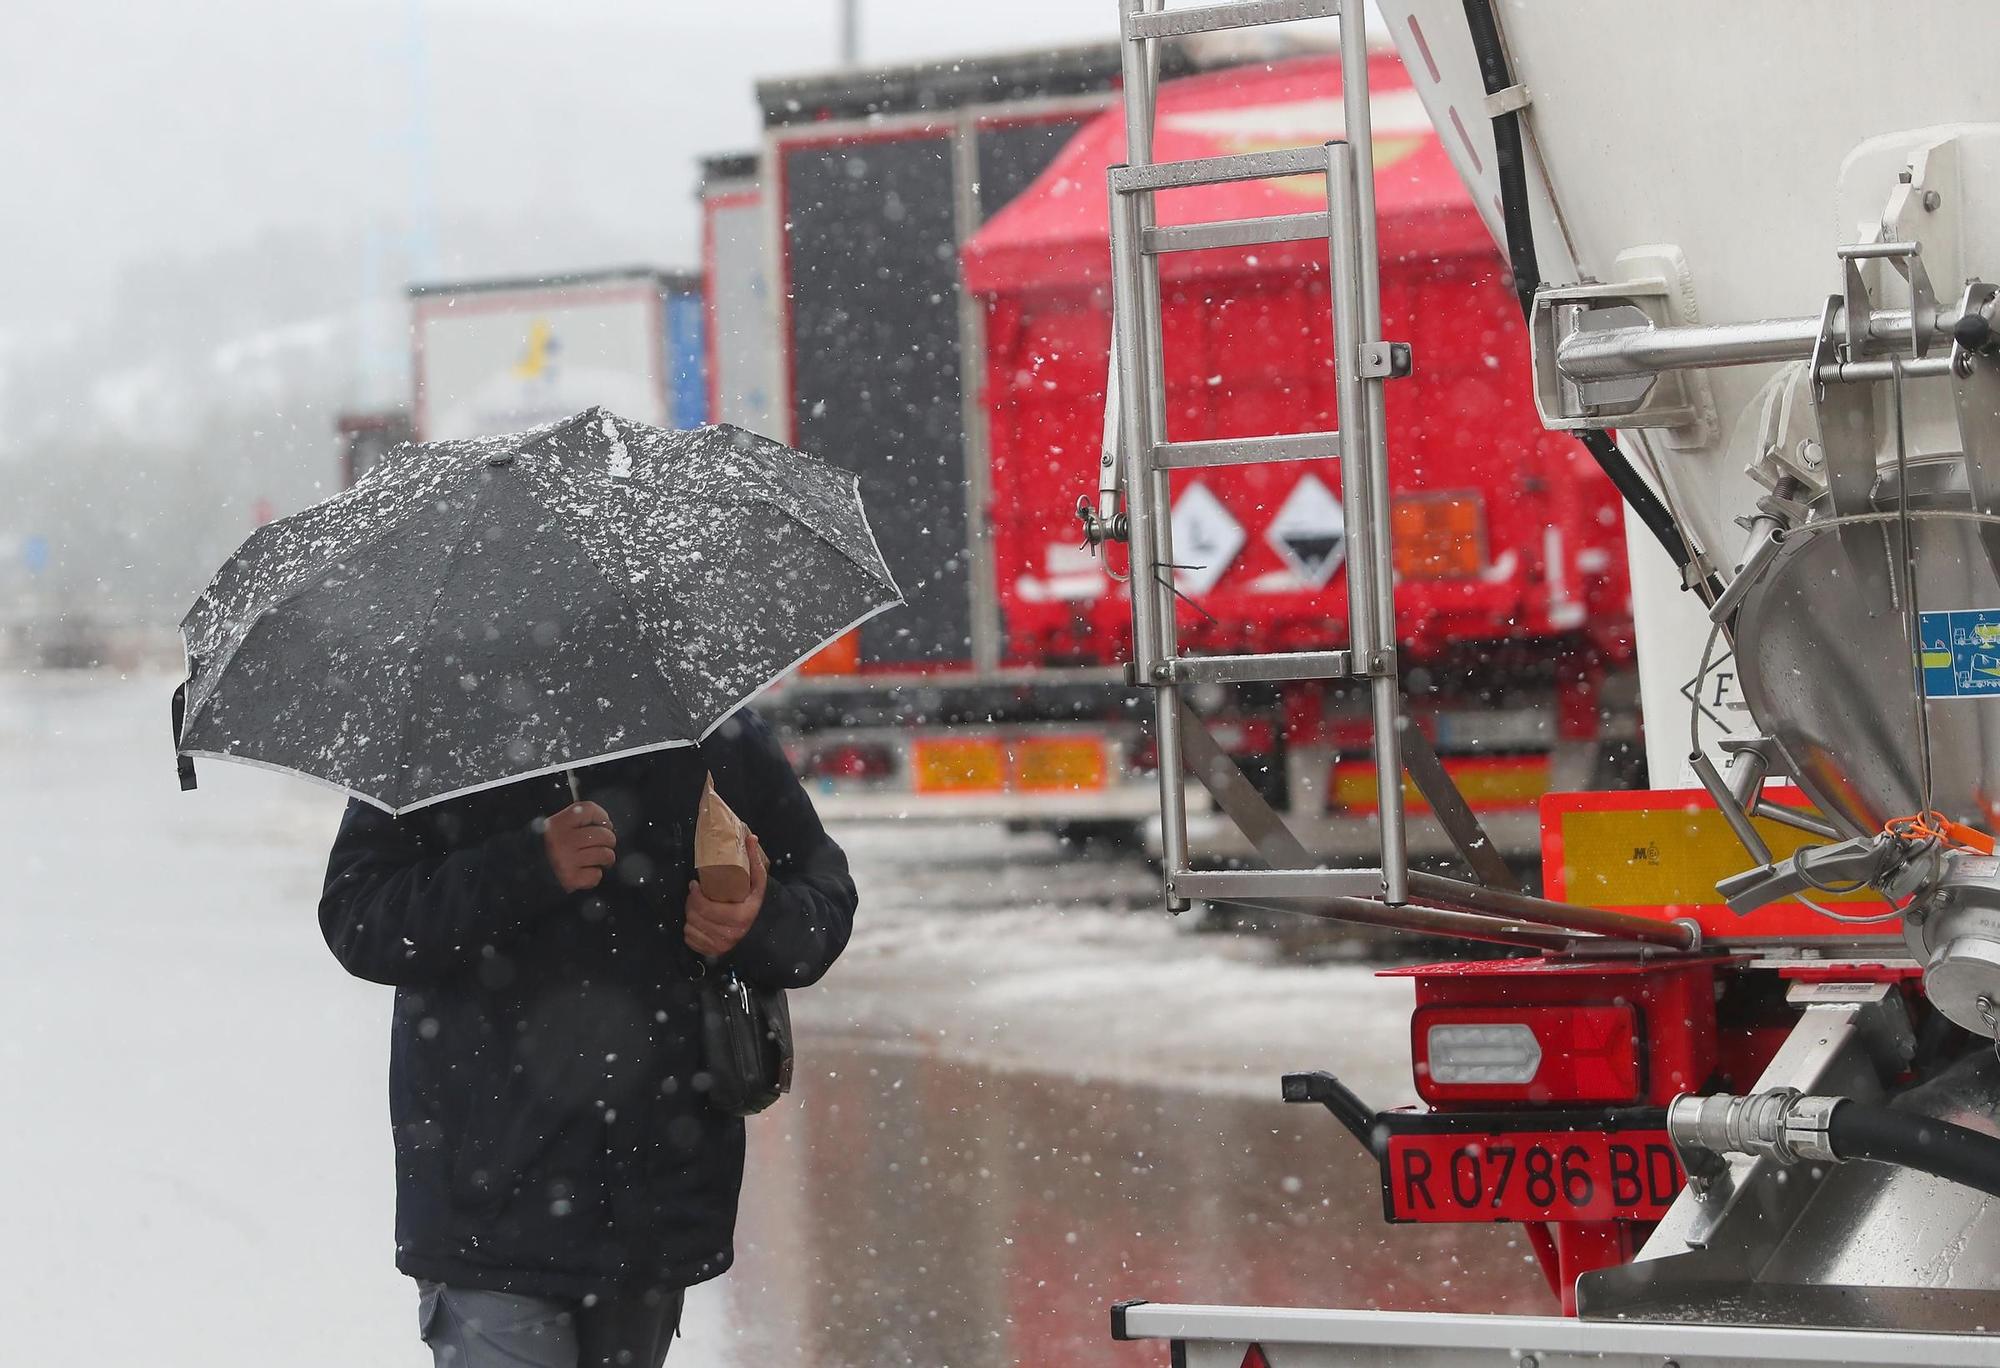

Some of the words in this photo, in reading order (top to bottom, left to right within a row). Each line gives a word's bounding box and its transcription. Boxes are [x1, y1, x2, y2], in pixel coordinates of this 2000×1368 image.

[1713, 673, 1733, 706] F
[1403, 1148, 1436, 1209] R
[1450, 1144, 1593, 1208] 0786
